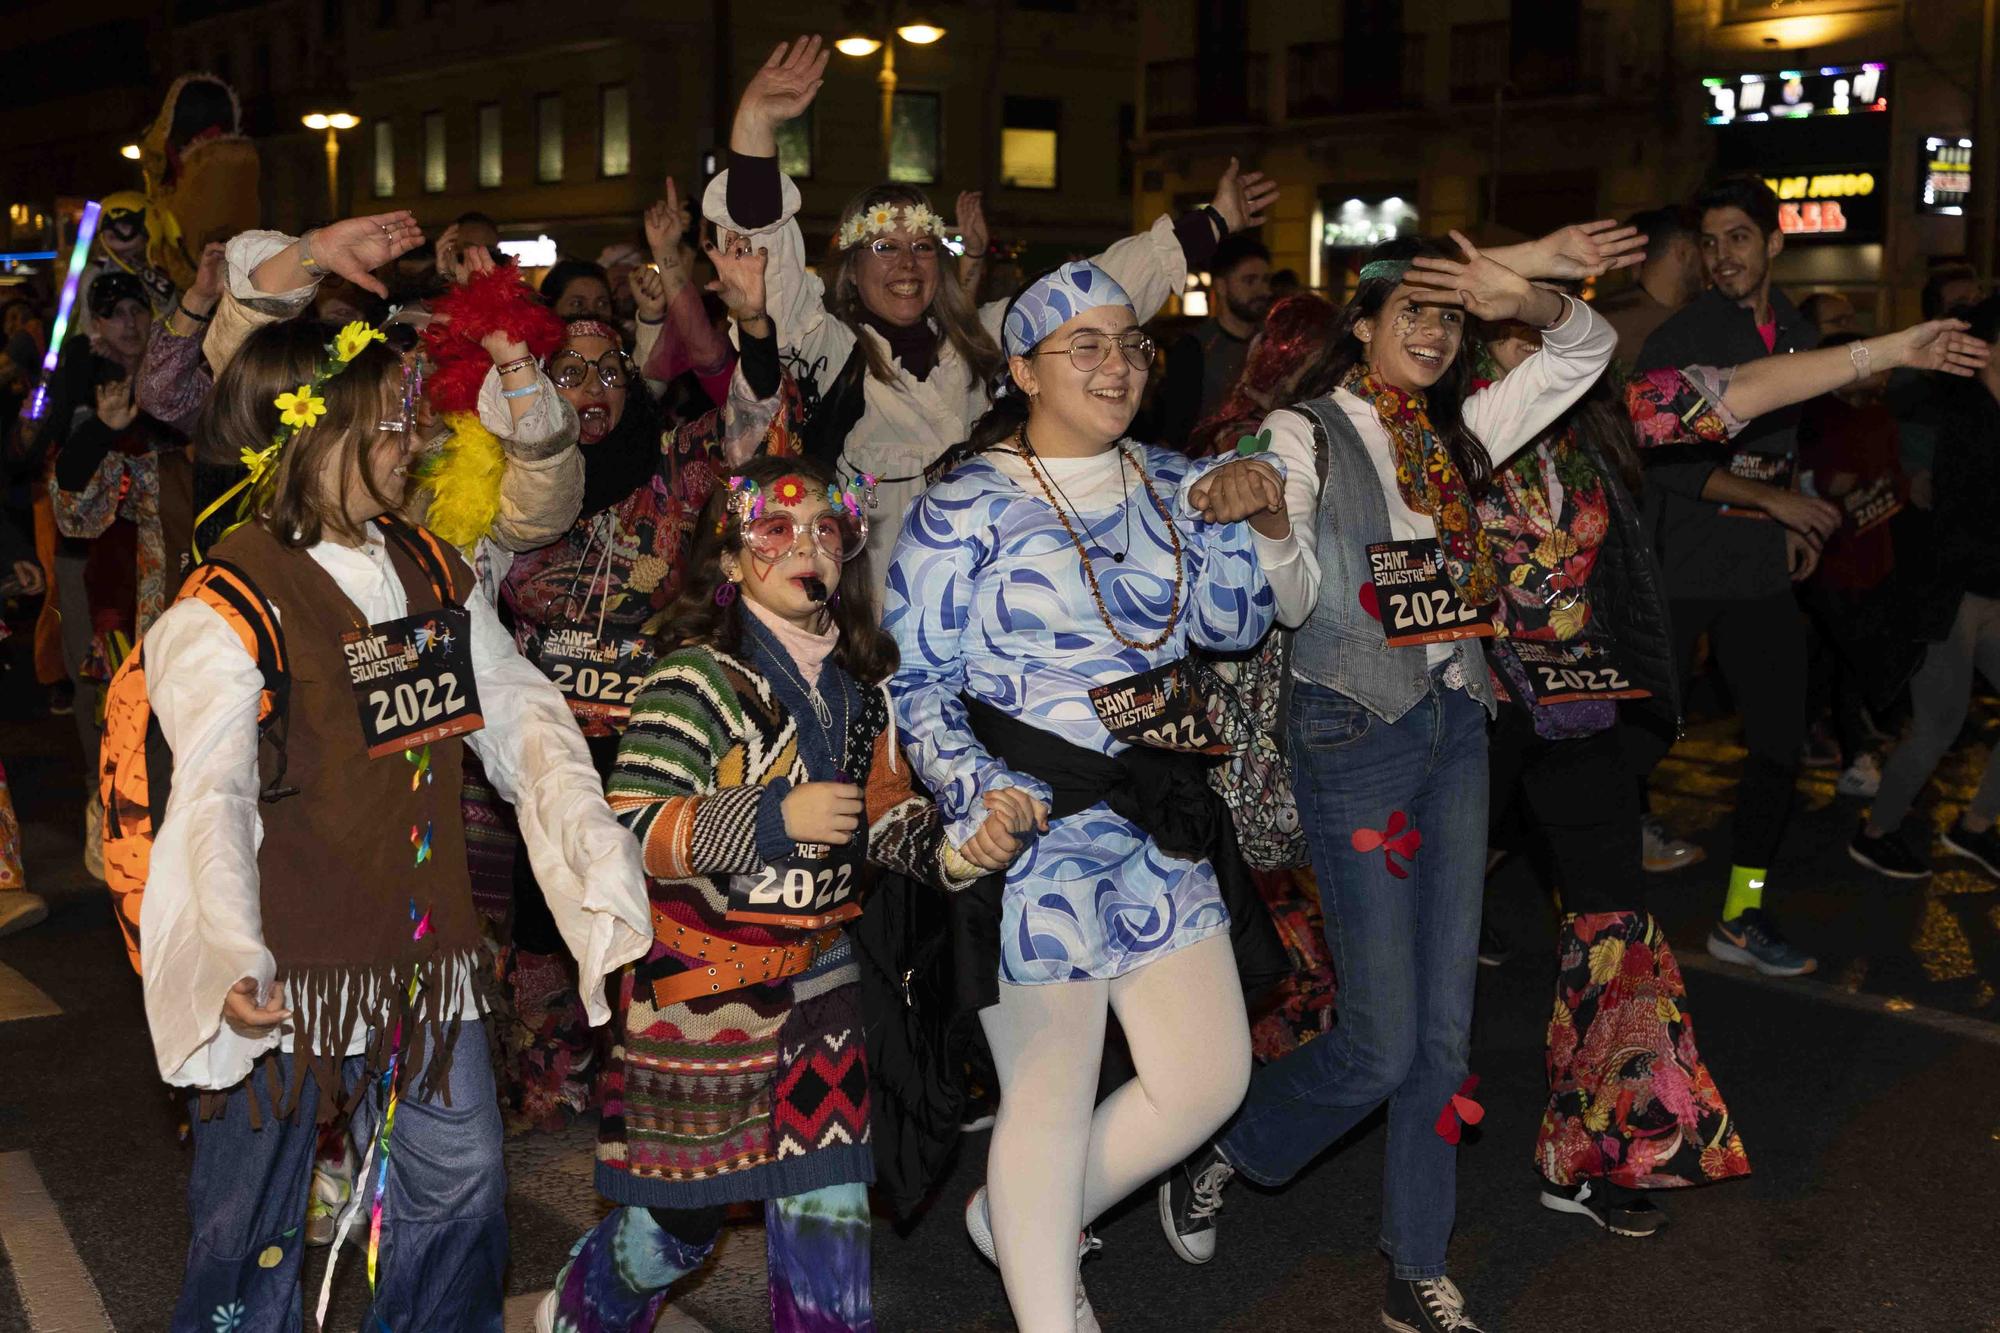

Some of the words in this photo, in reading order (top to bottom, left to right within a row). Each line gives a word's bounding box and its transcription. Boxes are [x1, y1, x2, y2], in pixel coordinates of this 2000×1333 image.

[1370, 550, 1409, 572] SANT
[344, 634, 389, 666] SANT
[548, 628, 593, 647] SANT
[552, 664, 644, 704] 2022
[1537, 666, 1630, 690] 2022
[369, 672, 466, 735] 2022
[1093, 687, 1136, 718] SANT
[748, 863, 852, 910] 2022
